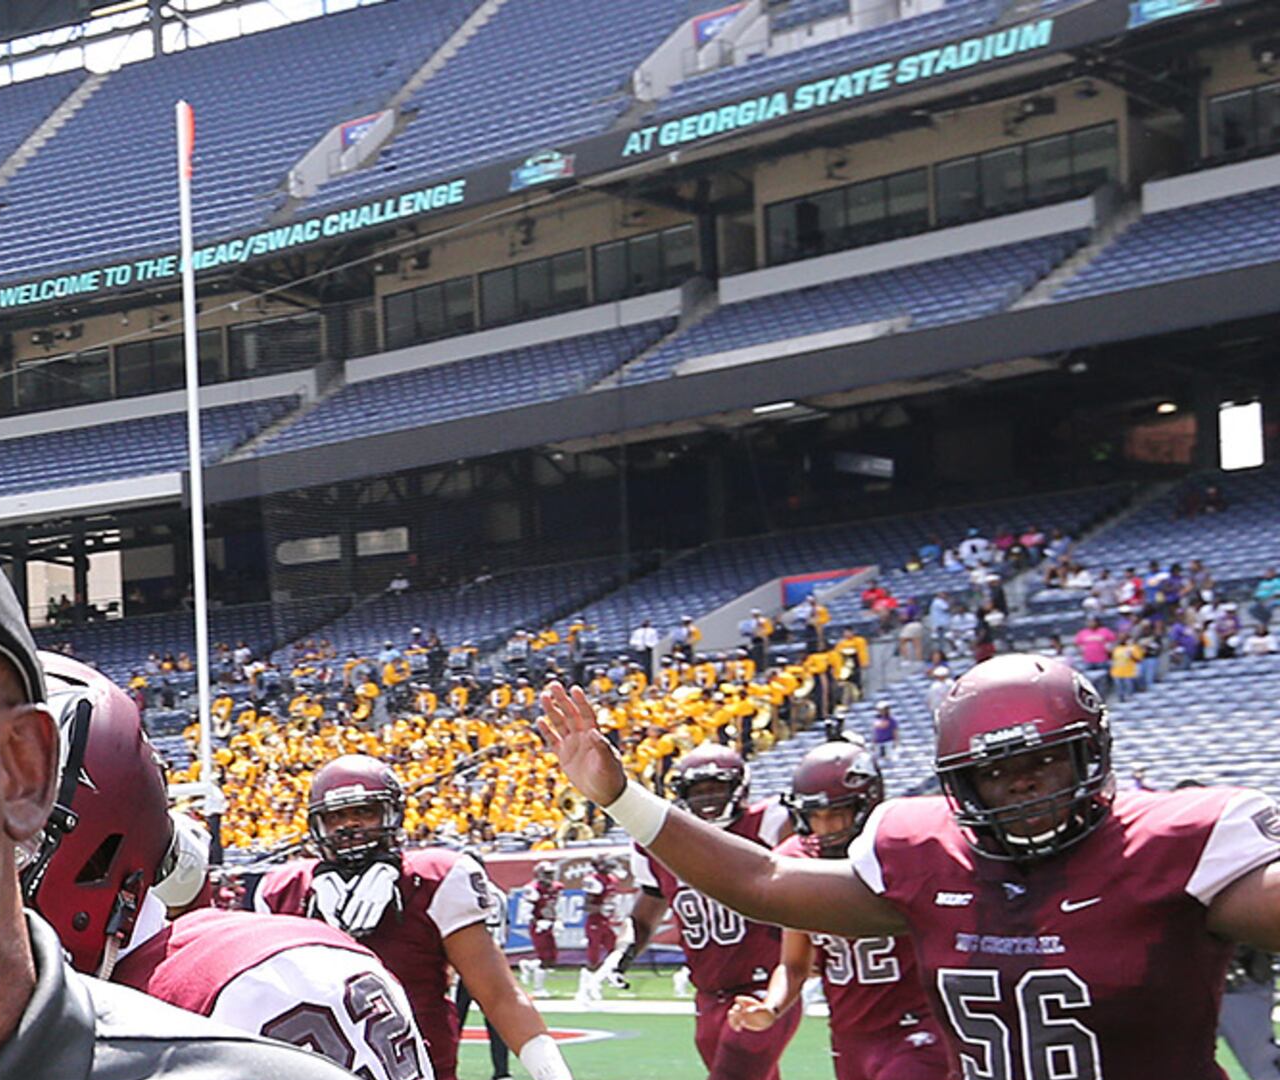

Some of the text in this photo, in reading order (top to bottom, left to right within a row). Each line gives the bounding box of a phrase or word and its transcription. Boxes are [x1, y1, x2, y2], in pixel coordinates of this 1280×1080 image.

[622, 19, 1055, 156] AT GEORGIA STATE STADIUM
[0, 269, 101, 307] WELCOME
[103, 264, 132, 287] TO
[135, 255, 177, 281] THE
[323, 179, 466, 237] CHALLENGE
[673, 889, 746, 950] 90
[809, 932, 901, 986] 32
